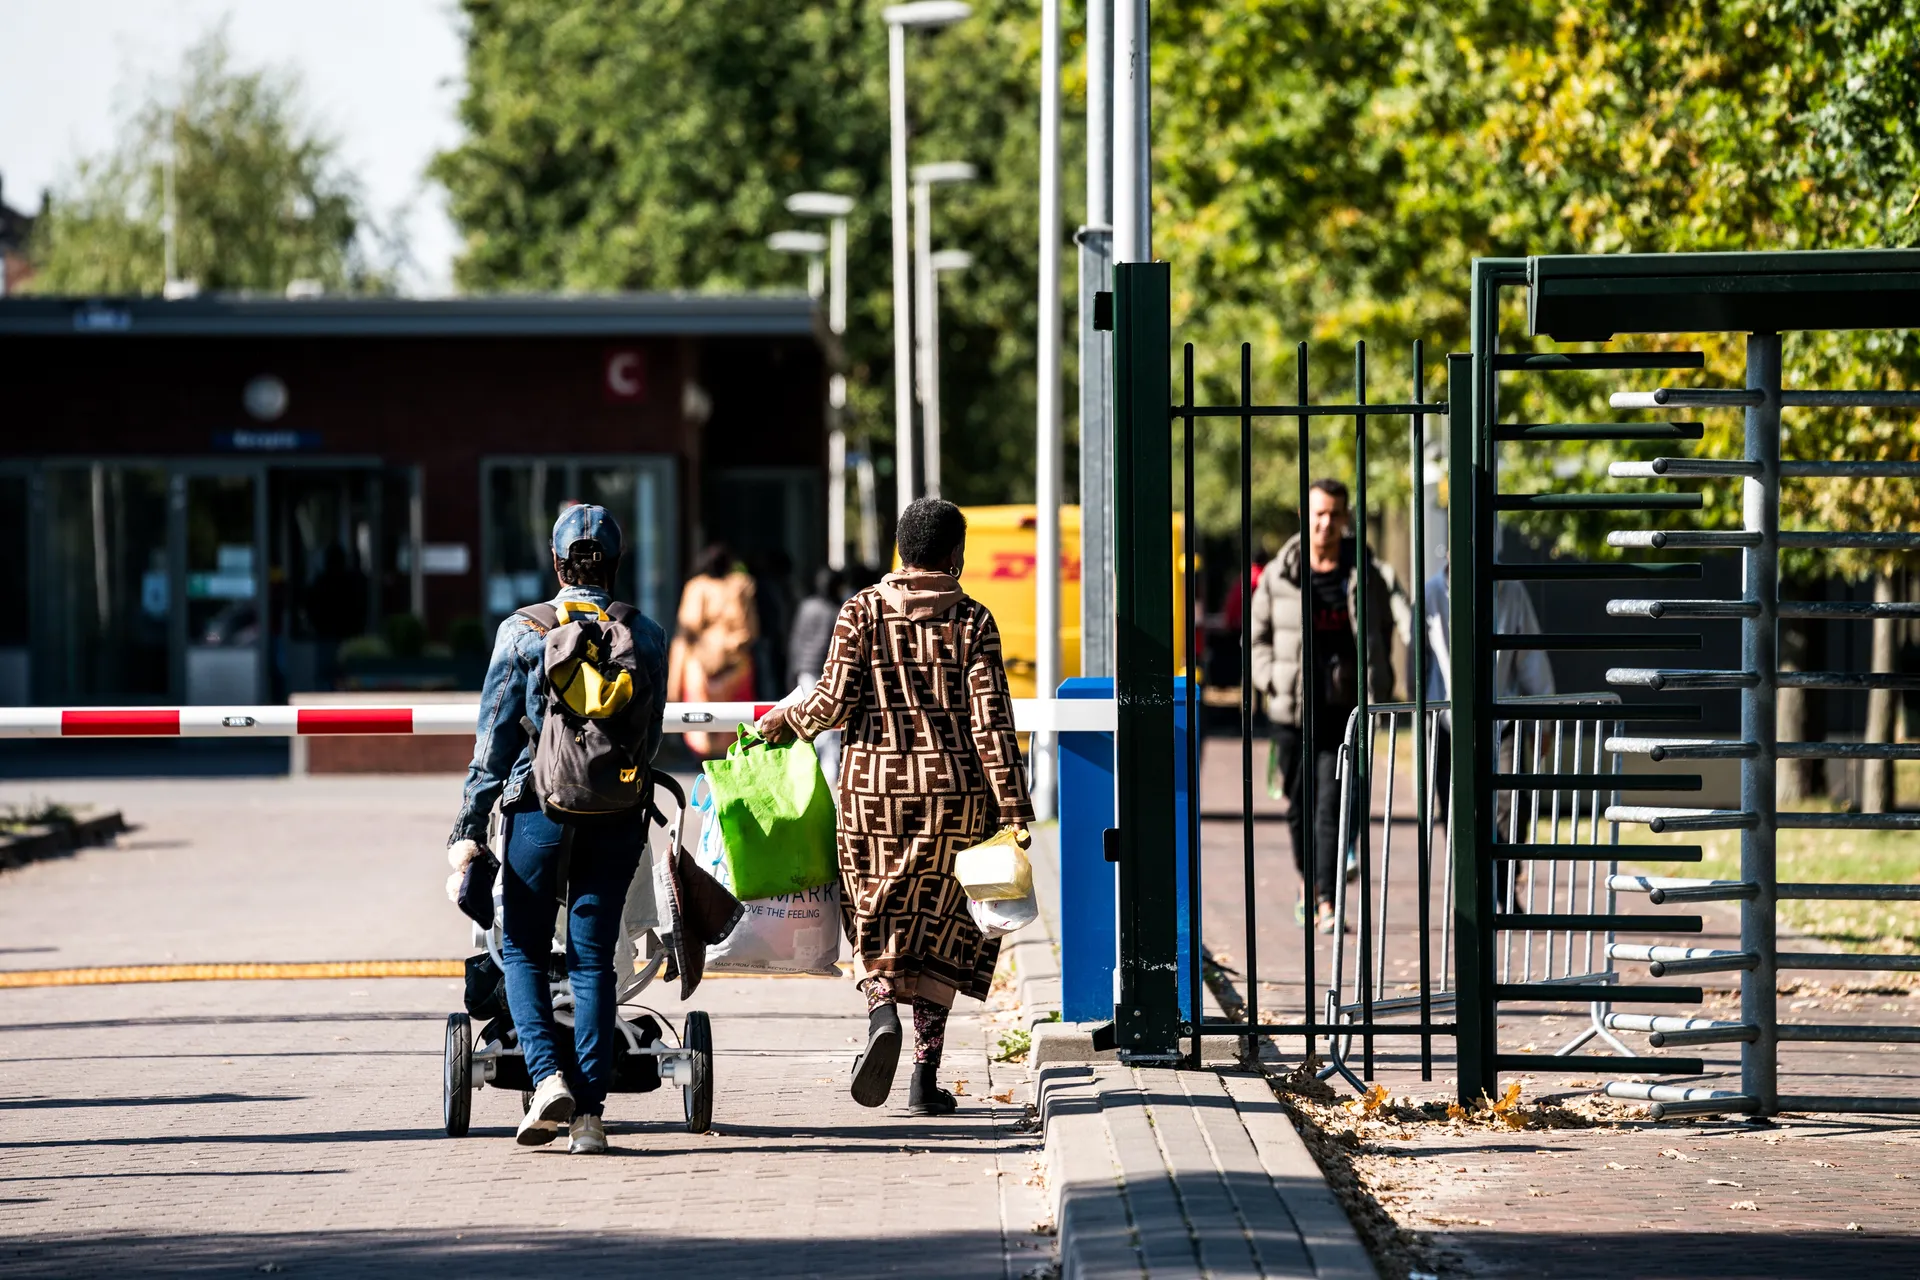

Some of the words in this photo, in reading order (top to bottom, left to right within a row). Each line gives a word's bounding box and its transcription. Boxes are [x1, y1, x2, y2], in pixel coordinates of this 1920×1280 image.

[609, 353, 641, 396] C
[744, 904, 763, 915] OVE
[767, 907, 785, 918] THE
[787, 909, 820, 919] FEELING
